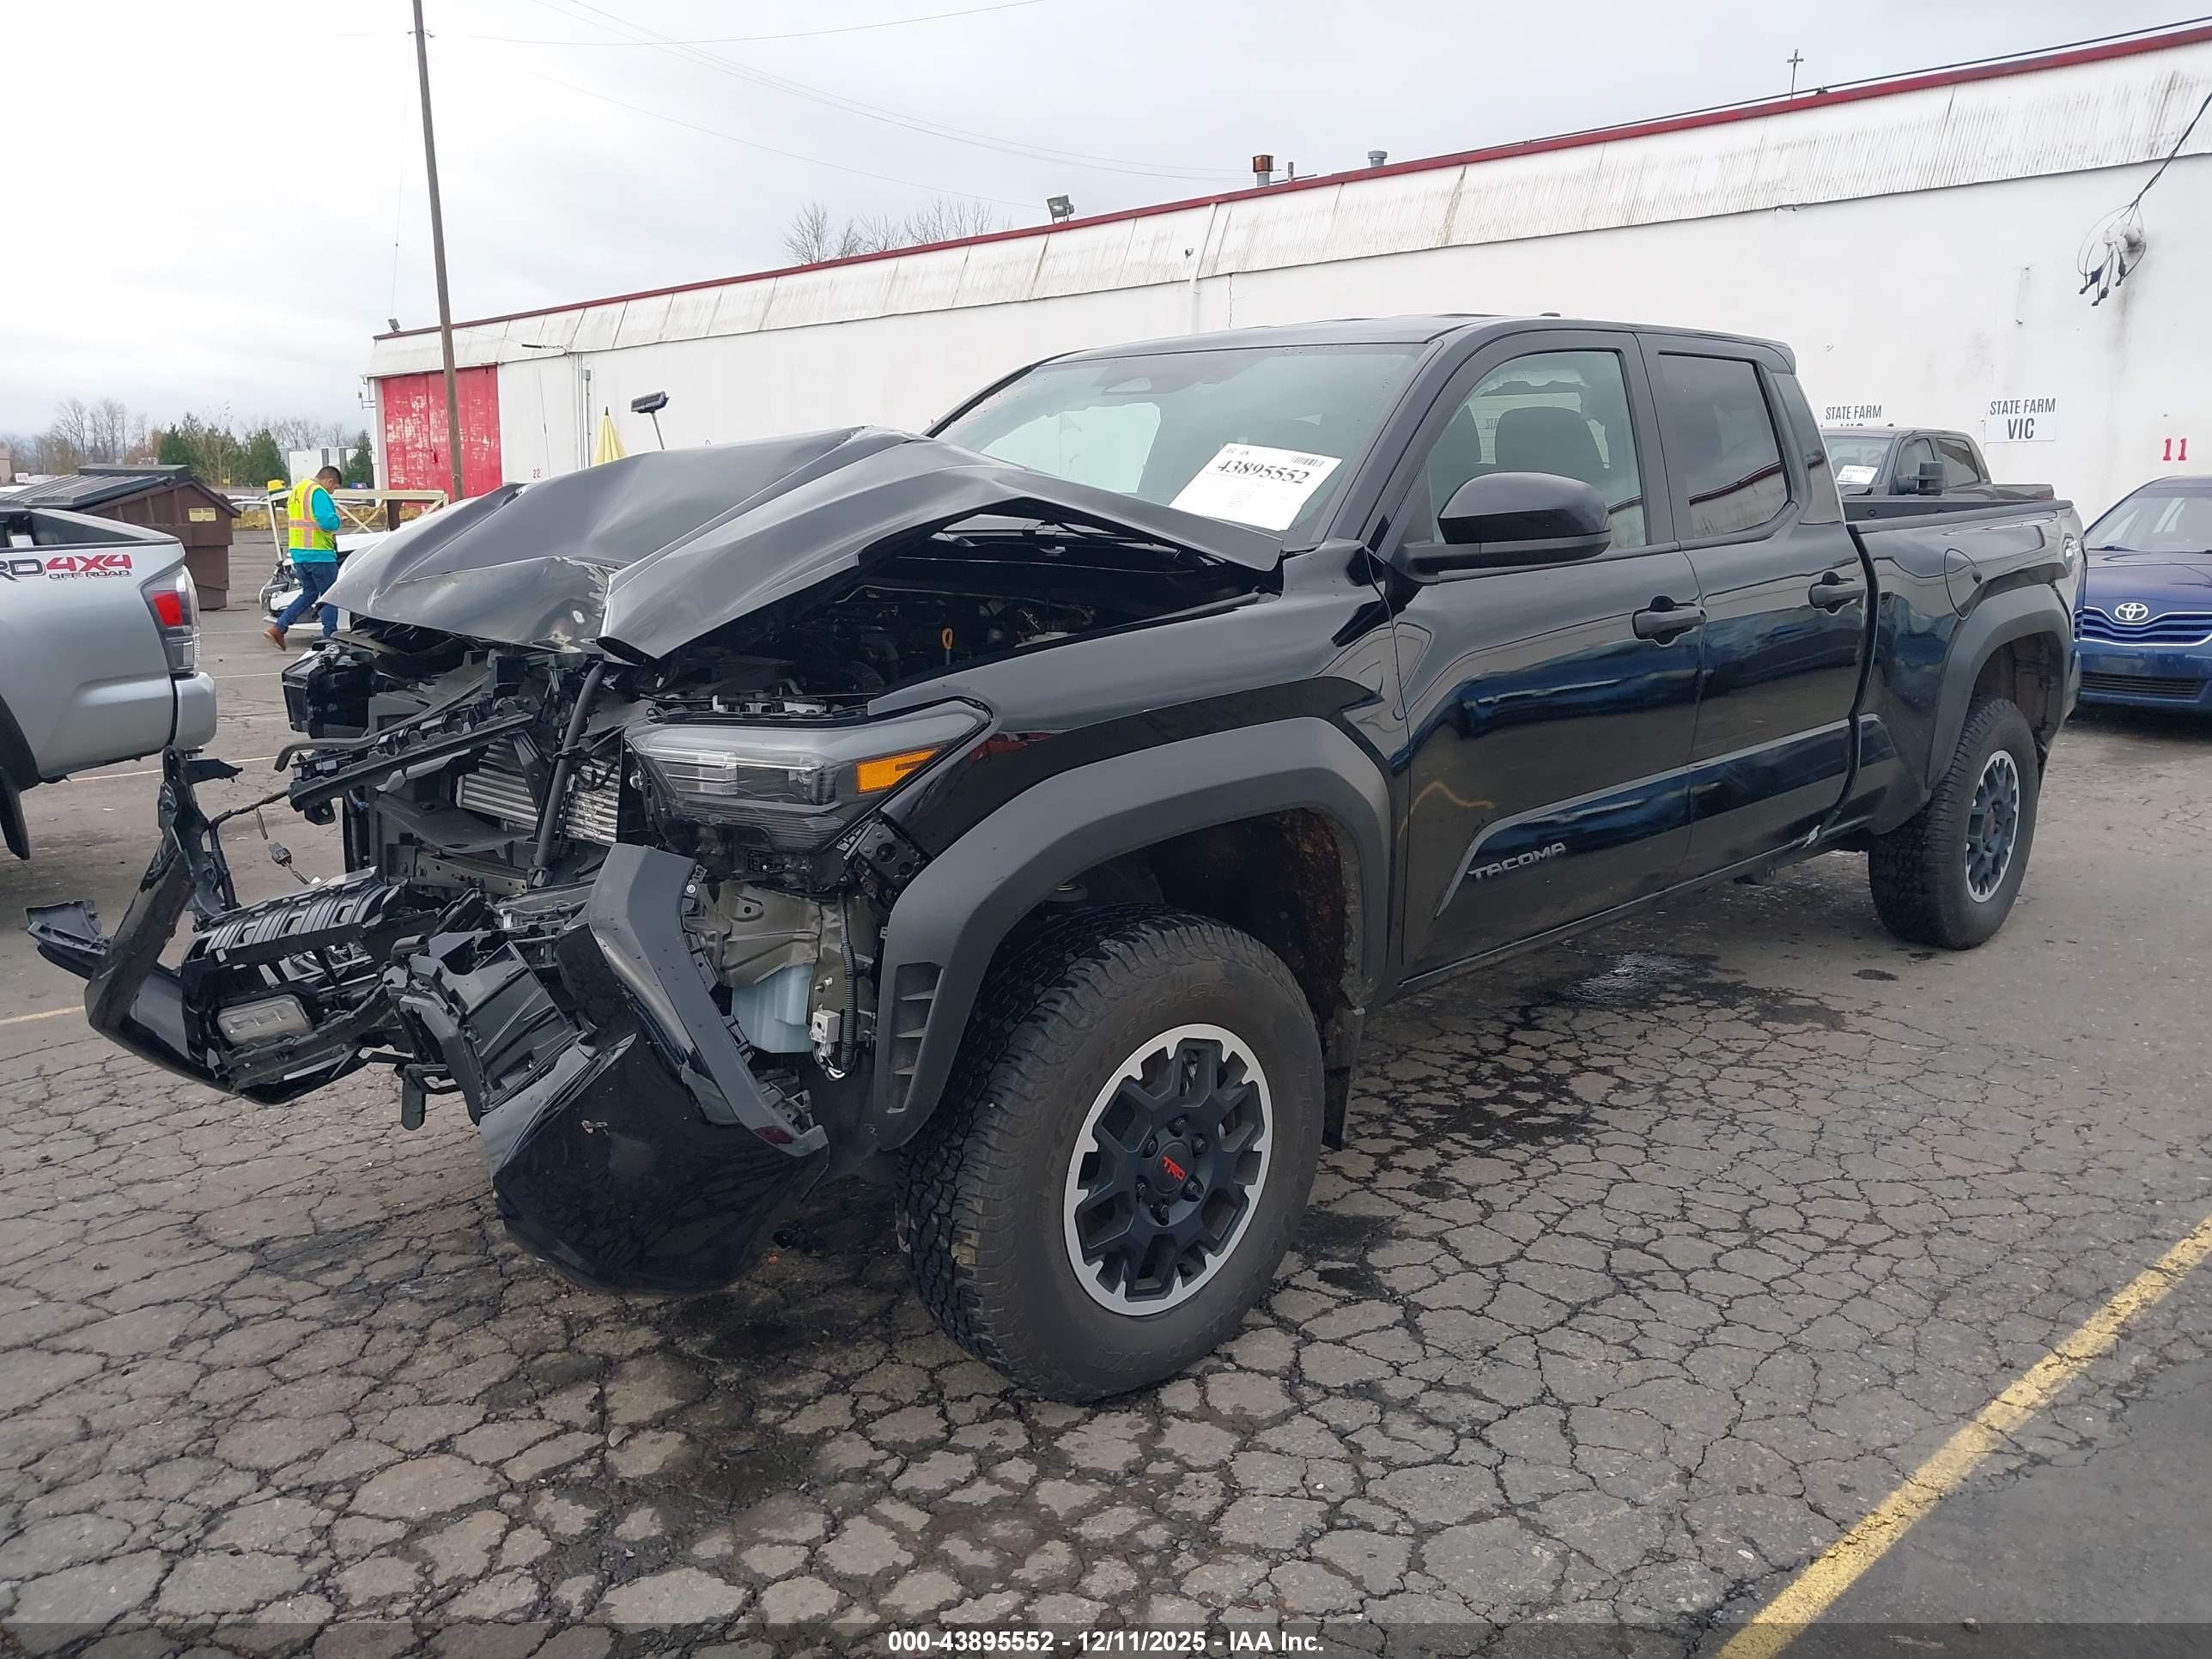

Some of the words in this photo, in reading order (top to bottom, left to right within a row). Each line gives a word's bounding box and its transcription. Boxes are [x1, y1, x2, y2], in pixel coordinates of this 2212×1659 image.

[1826, 406, 1851, 420] STATE
[1854, 404, 1882, 419] FARM
[1990, 399, 2021, 416] STATE
[2023, 398, 2056, 414] FARM
[2008, 417, 2034, 440] VIC
[2163, 437, 2187, 461] 11
[532, 468, 541, 479] 22
[1218, 459, 1310, 484] 43895552
[49, 572, 83, 580] OFF
[85, 569, 131, 579] ROAD
[1467, 842, 1566, 879] TACOMA
[1162, 1156, 1186, 1182] TRD
